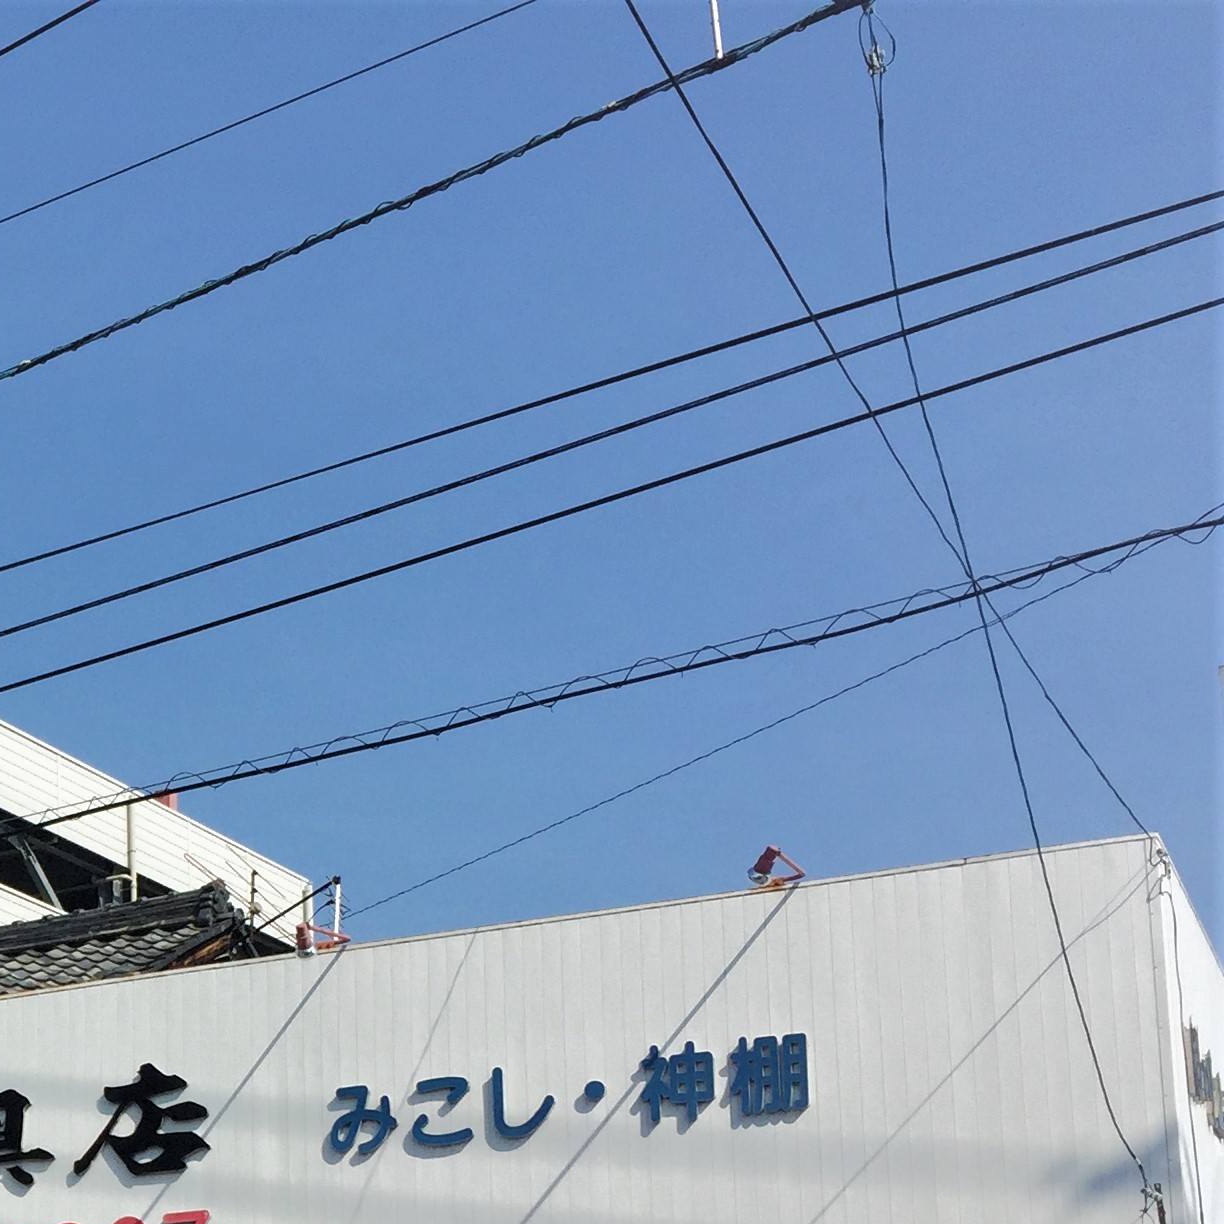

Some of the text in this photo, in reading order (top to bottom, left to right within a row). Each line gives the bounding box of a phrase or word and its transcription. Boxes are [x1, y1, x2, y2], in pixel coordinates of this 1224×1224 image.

[330, 1032, 810, 1155] みこし・神棚
